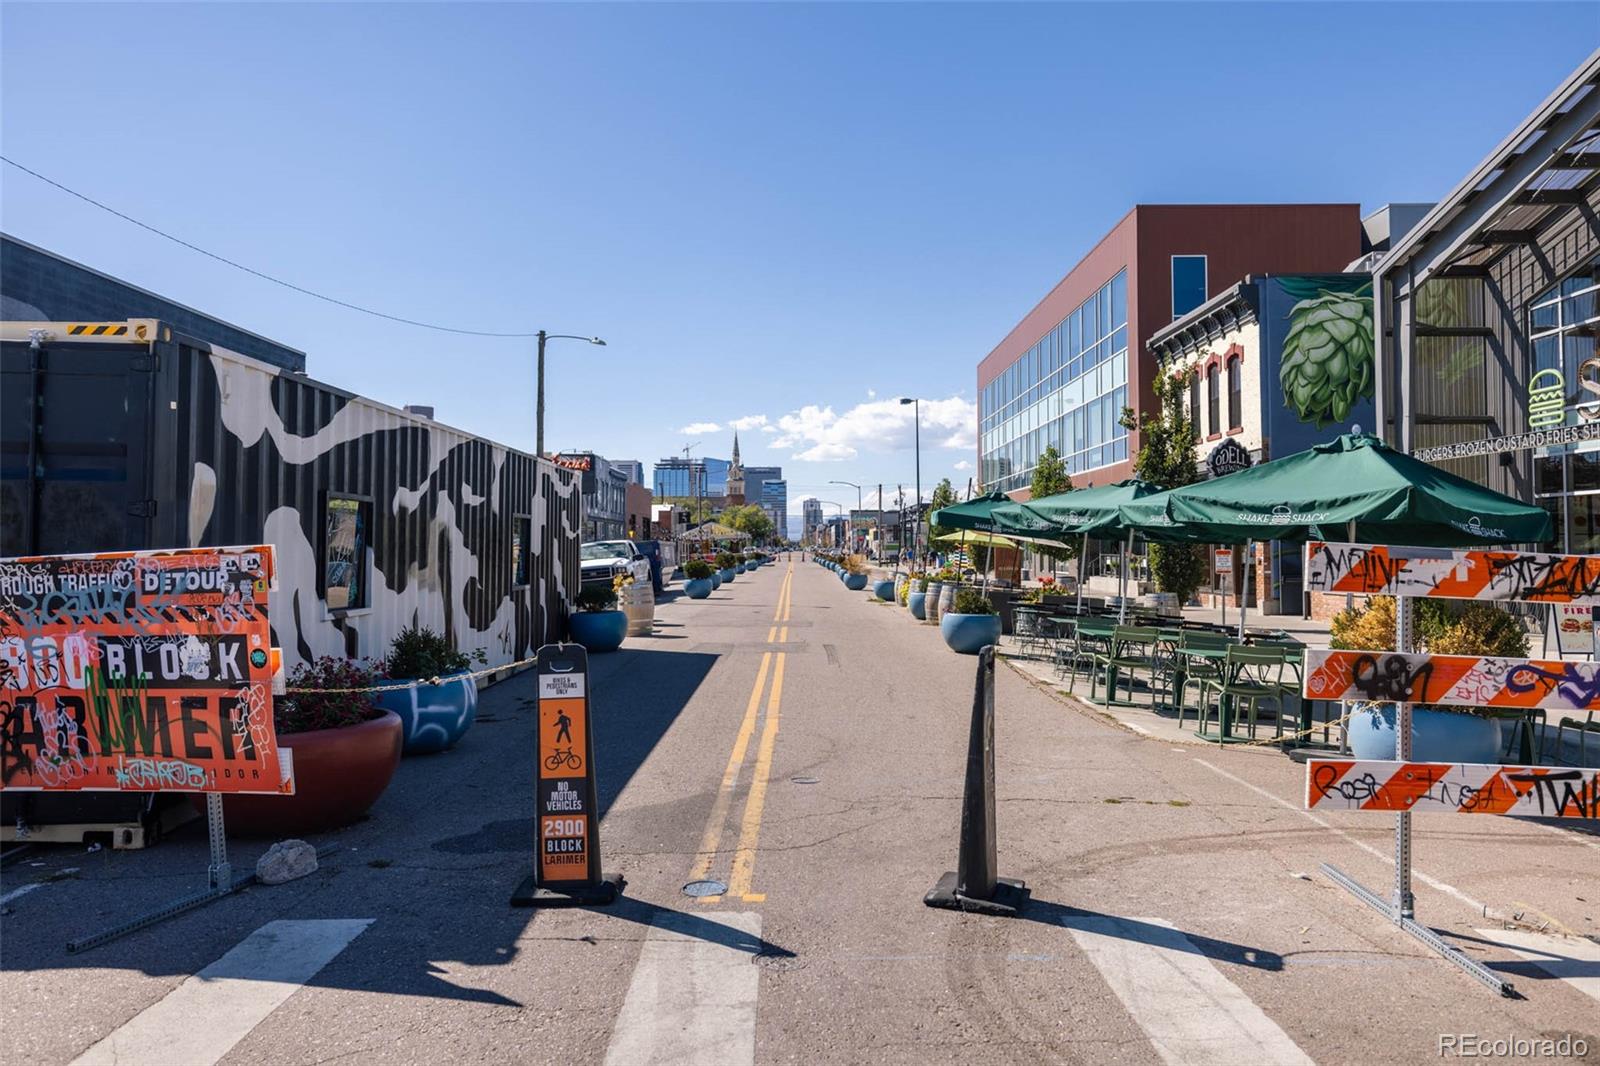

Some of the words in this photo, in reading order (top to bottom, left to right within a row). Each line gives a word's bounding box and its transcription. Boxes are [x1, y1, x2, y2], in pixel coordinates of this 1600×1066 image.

[1414, 446, 1453, 462] BURGERS
[1456, 440, 1494, 457] FROZEN
[1495, 432, 1545, 451] CUSTARD
[1547, 427, 1578, 444] FRIES
[1238, 513, 1270, 523] SHAKE
[1291, 513, 1328, 523] SHACK
[144, 570, 229, 591] DETOUR
[1564, 607, 1592, 615] FIRE
[546, 682, 578, 690] PEDESTRIANS
[557, 781, 569, 791] NO
[551, 790, 578, 801] MOTOR
[546, 800, 582, 812] VEHICLES
[544, 820, 585, 837] 2900
[547, 839, 582, 853] BLOCK
[544, 854, 586, 866] LARIMER
